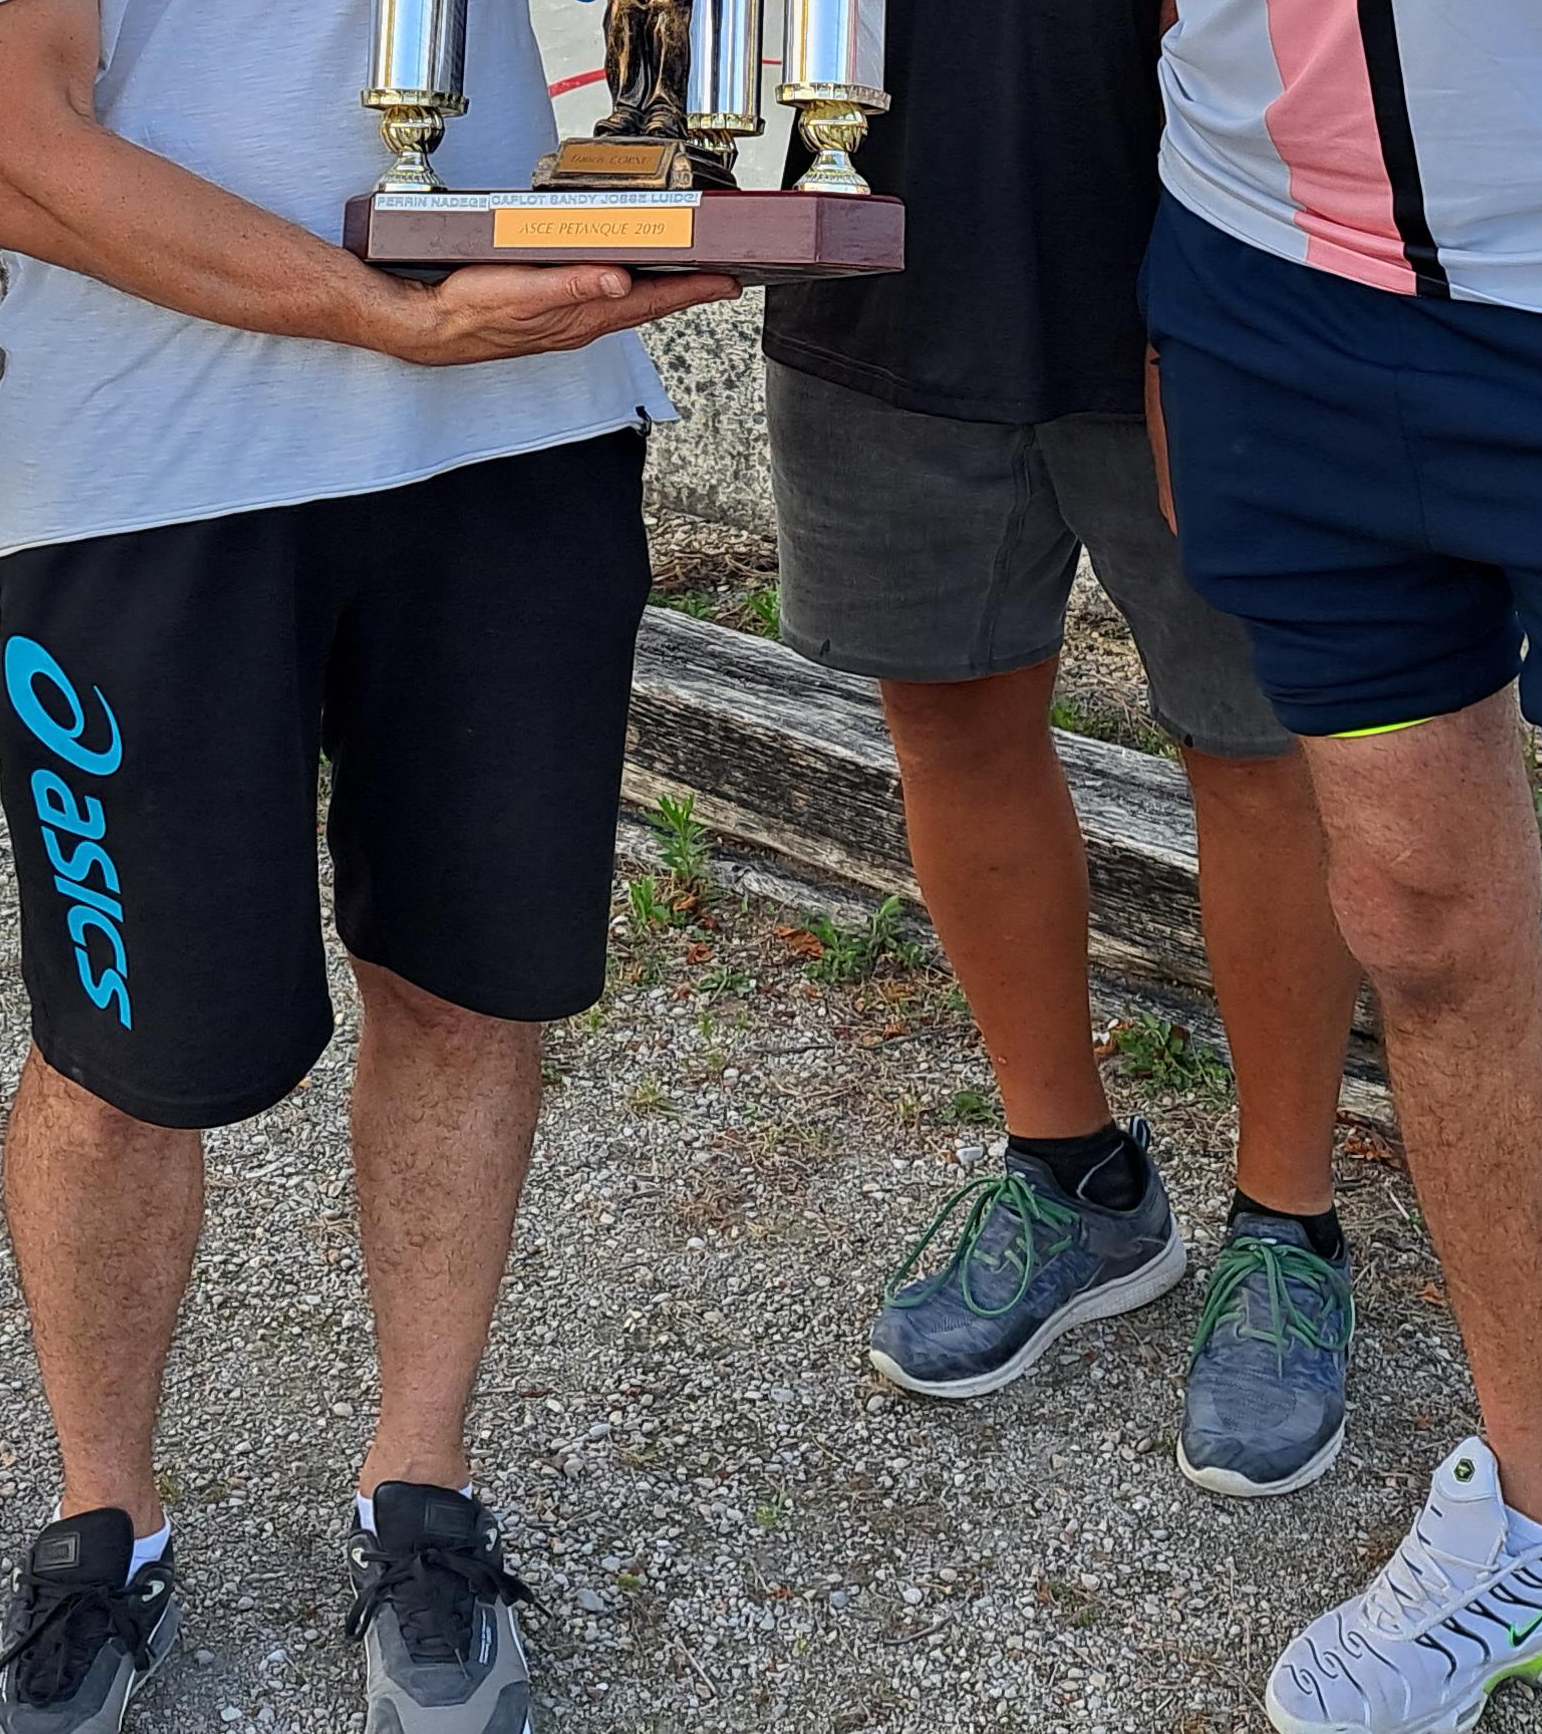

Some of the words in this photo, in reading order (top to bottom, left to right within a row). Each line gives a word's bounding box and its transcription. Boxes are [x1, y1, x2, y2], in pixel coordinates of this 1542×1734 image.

[519, 222, 553, 235] ASCE
[558, 222, 629, 237] PETANQUE
[634, 222, 666, 235] 2019
[30, 767, 133, 1032] asics
